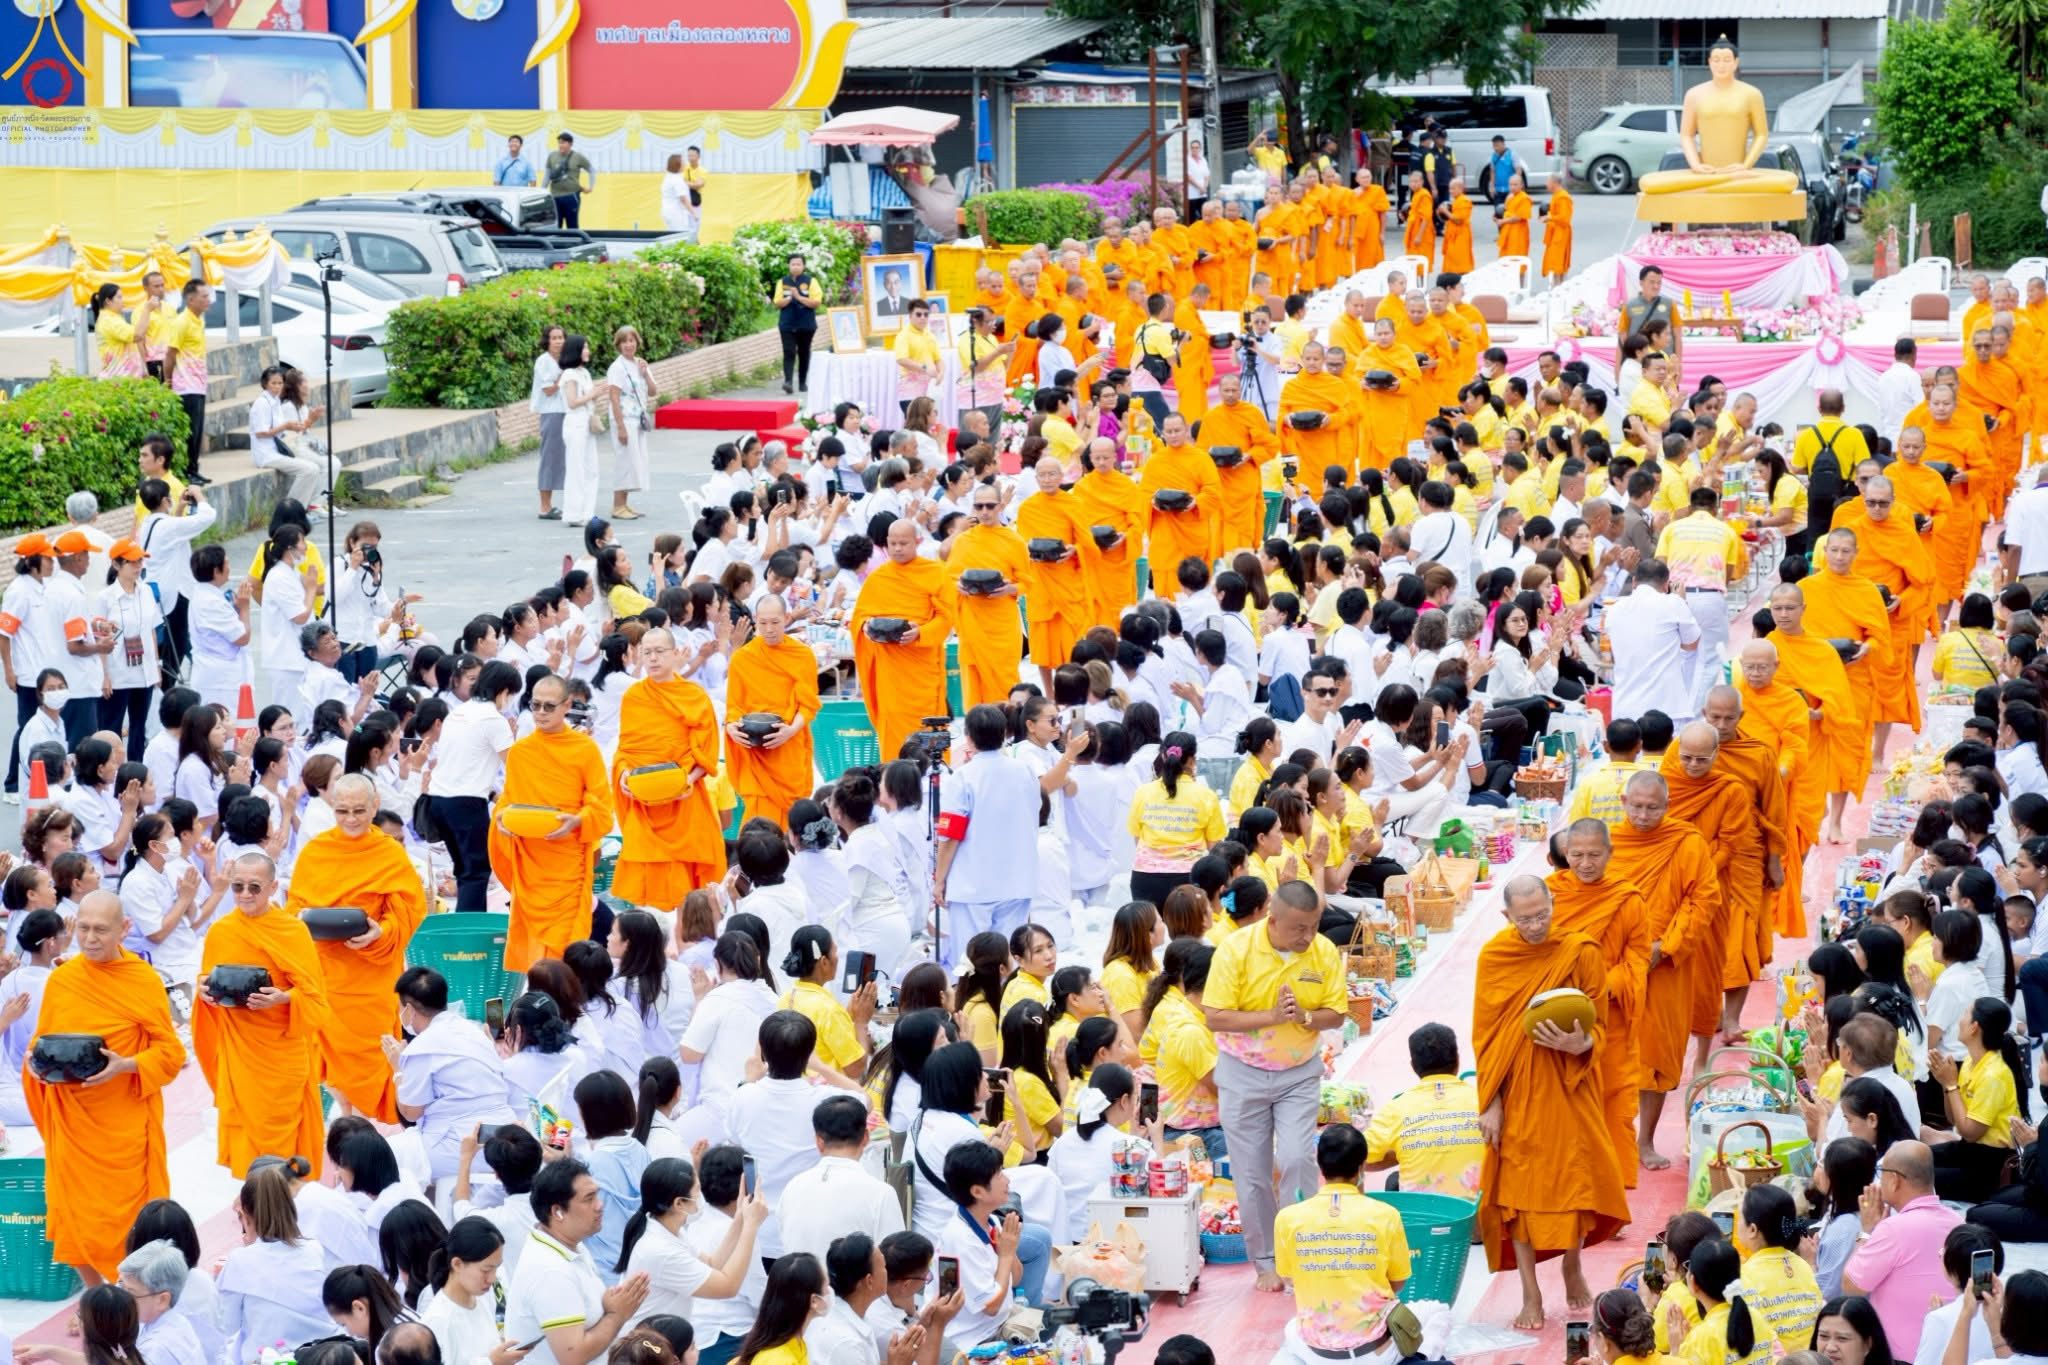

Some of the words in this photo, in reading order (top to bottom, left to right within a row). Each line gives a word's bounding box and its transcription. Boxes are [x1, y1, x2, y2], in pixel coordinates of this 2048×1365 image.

[597, 20, 790, 43] เทศบาลเมืองคลองหลวง
